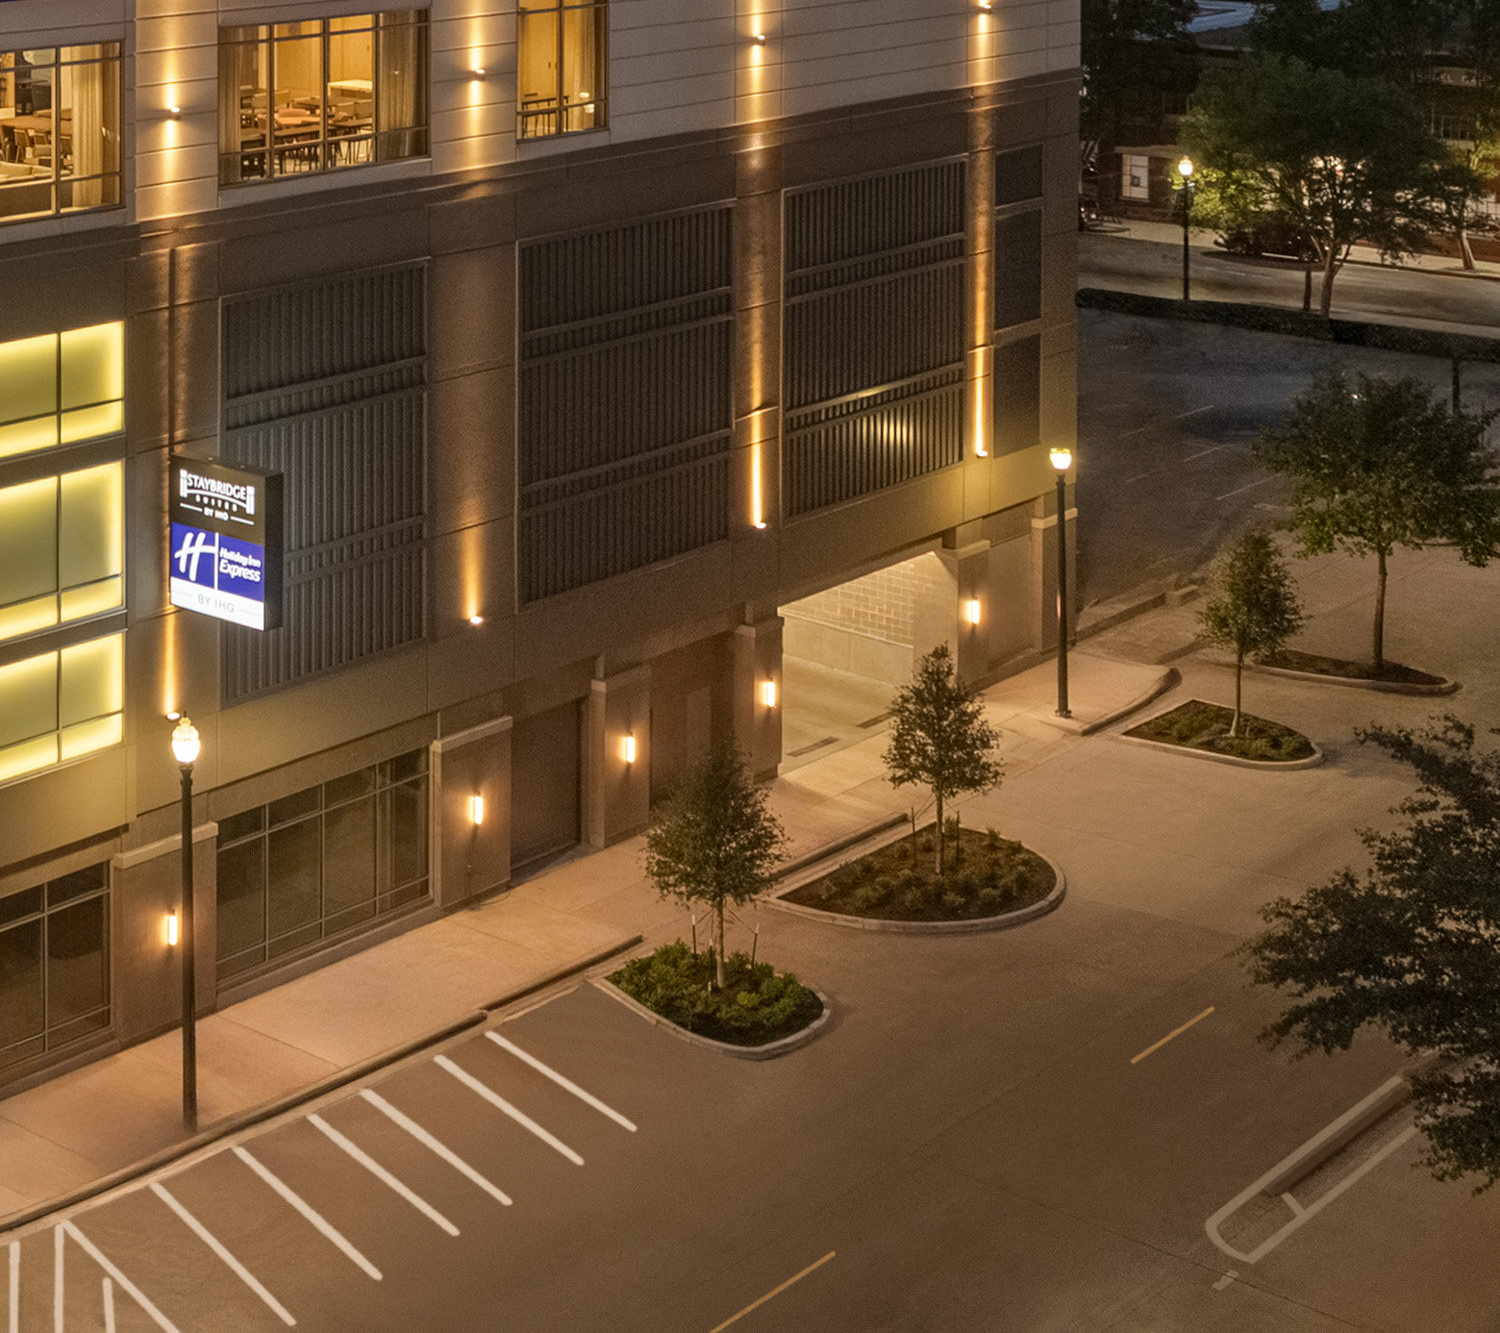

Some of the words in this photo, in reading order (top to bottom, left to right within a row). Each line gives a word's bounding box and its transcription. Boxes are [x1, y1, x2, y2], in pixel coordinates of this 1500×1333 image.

[186, 472, 247, 501] STAYBRIDGE
[195, 494, 238, 512] SUITES
[203, 507, 214, 517] BY
[219, 546, 247, 566] Holiday
[247, 554, 261, 568] Inn
[219, 559, 261, 583] Express
[197, 593, 211, 606] BY
[214, 598, 236, 613] IHG
